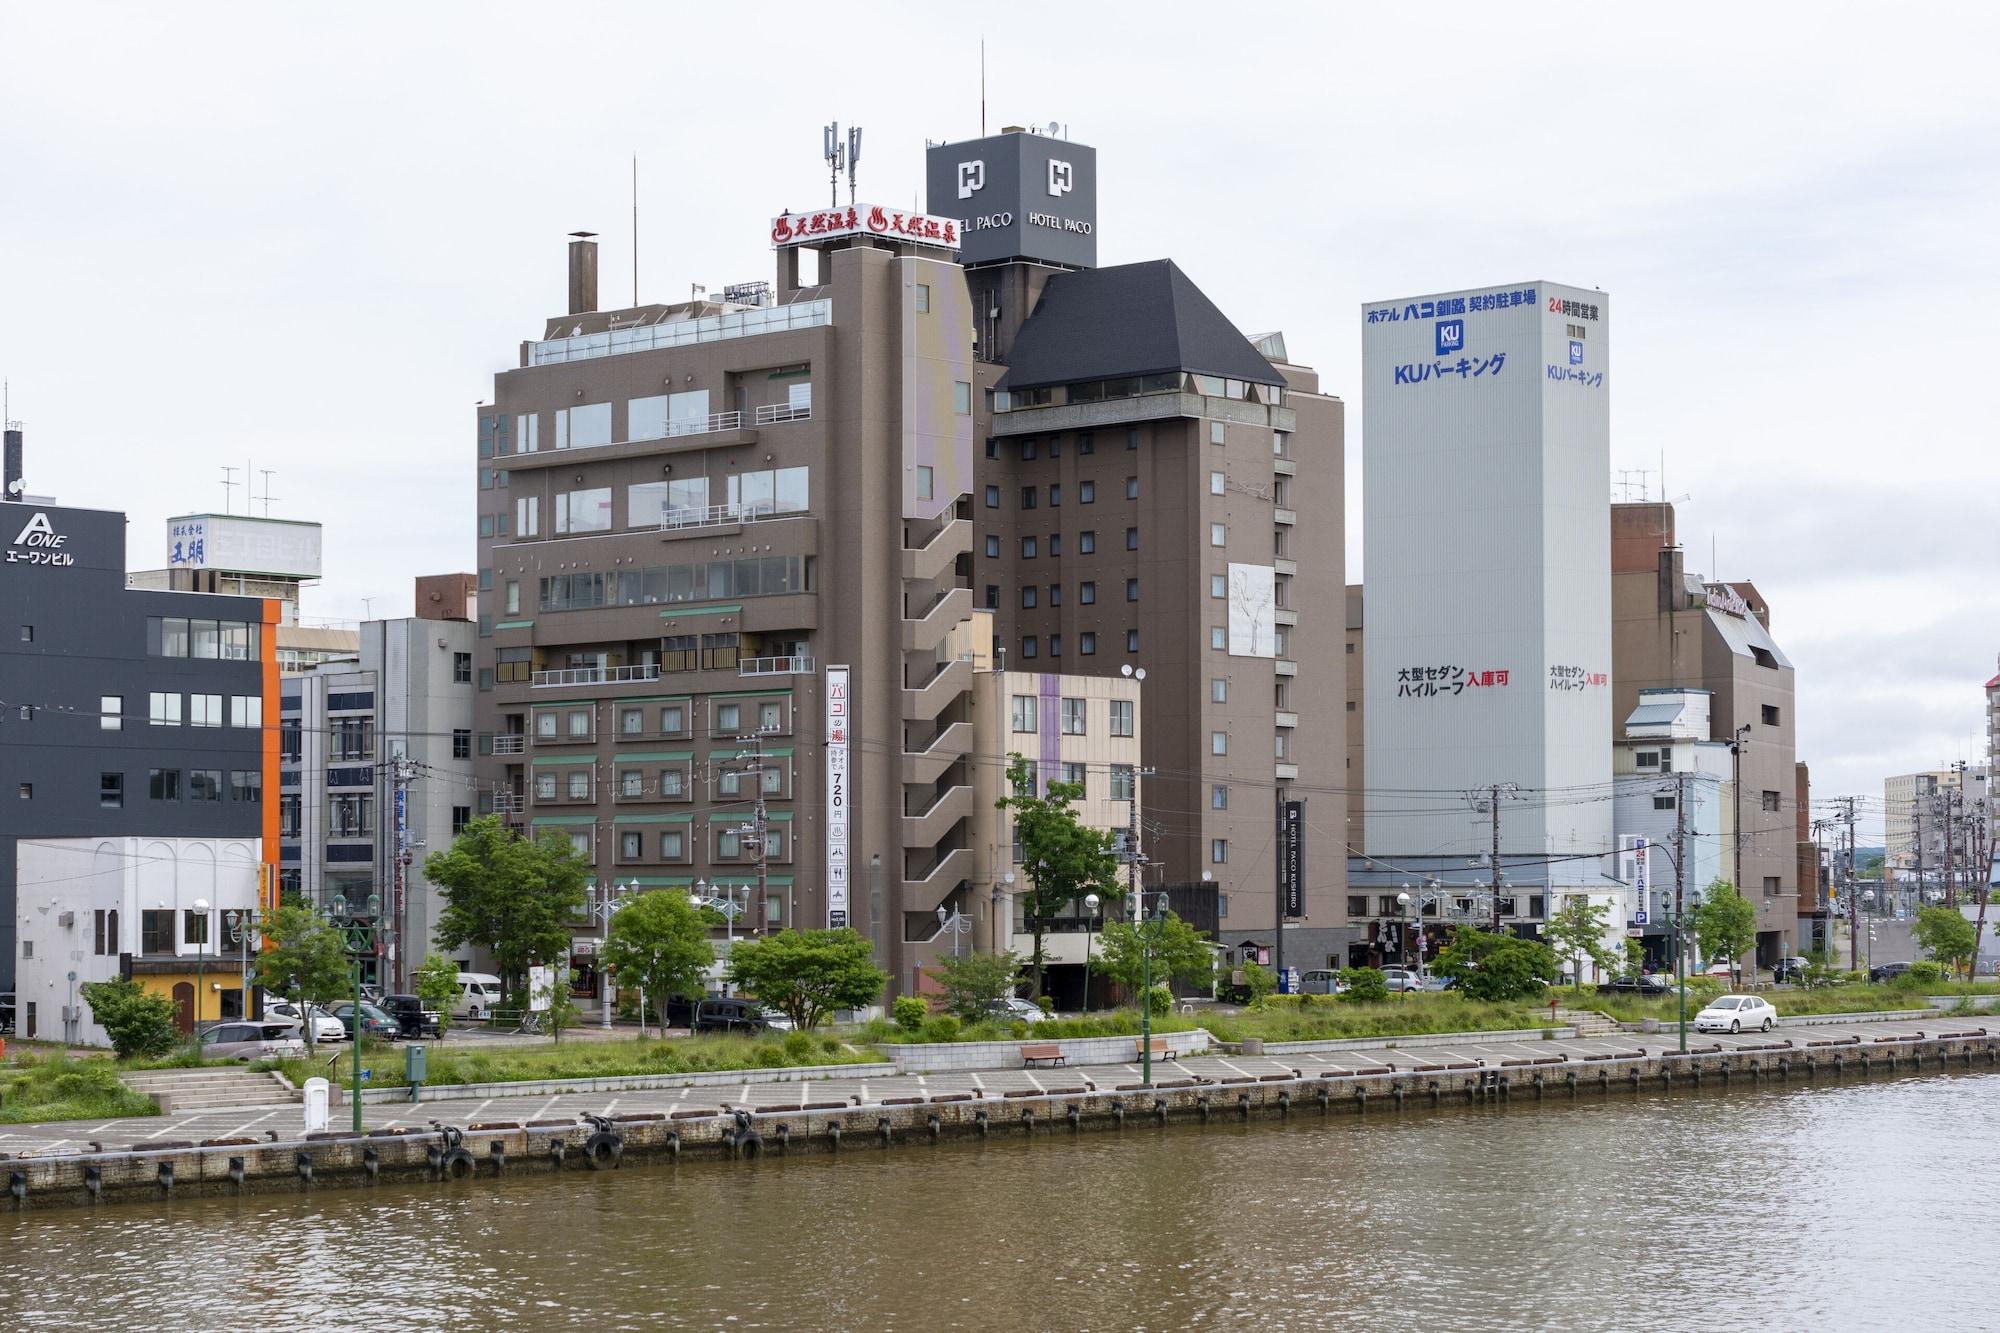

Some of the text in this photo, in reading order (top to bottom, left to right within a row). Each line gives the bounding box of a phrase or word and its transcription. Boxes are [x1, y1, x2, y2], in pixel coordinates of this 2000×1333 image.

[794, 207, 860, 237] 天然温泉
[891, 213, 957, 243] 天然温泉
[977, 211, 1013, 231] PACO
[1029, 211, 1092, 235] HOTEL PACO
[1367, 289, 1536, 324] ホテル パコ釧路 契約駐車場
[1549, 297, 1599, 322] 24時間営業
[1440, 324, 1460, 343] KU
[1394, 352, 1506, 385] KUパーキング
[1547, 364, 1603, 388] KUパーキング
[173, 524, 203, 537] 株式会社
[6, 550, 74, 567] エーワンビル
[1398, 665, 1465, 682] 大型セダン
[1466, 670, 1510, 688] 入庫可
[1549, 664, 1586, 679] 大型セダン
[1585, 672, 1608, 687] 入庫可
[1398, 680, 1465, 698] ハイルーフ
[1549, 679, 1586, 692] ハイルーフ
